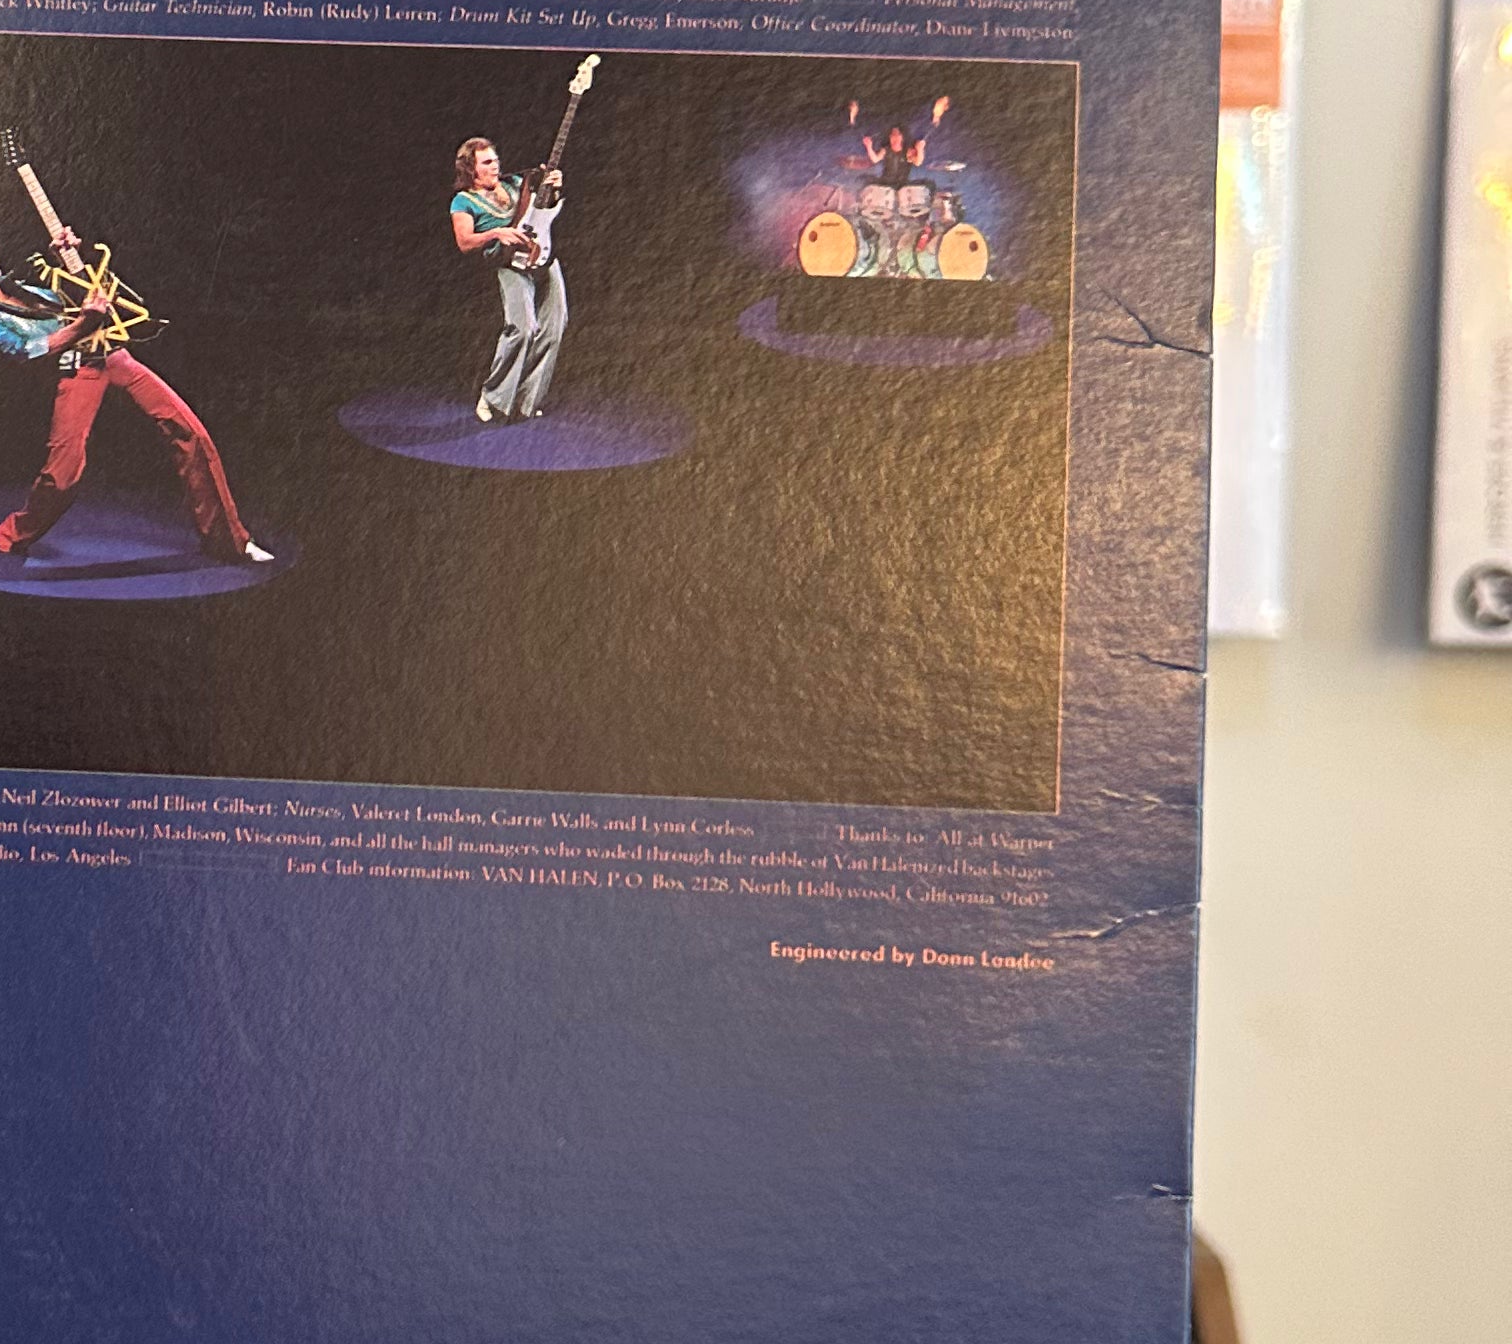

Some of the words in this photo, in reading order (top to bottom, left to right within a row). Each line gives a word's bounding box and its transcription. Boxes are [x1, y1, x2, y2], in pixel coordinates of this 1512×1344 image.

[262, 0, 314, 18] Robin
[319, 2, 380, 24] (Rudy)
[449, 6, 500, 24] Drum
[537, 9, 565, 26] Set
[571, 10, 601, 31] Up,
[126, 793, 160, 811] and
[284, 800, 346, 822] Nurses,
[152, 823, 231, 847] Madison,
[329, 831, 363, 849] and
[65, 847, 132, 870] Angeles
[286, 856, 317, 874] Fan
[769, 941, 886, 965] Engineered
[891, 945, 915, 966] by
[921, 946, 976, 965] Donn
[980, 949, 1055, 968] Landee
